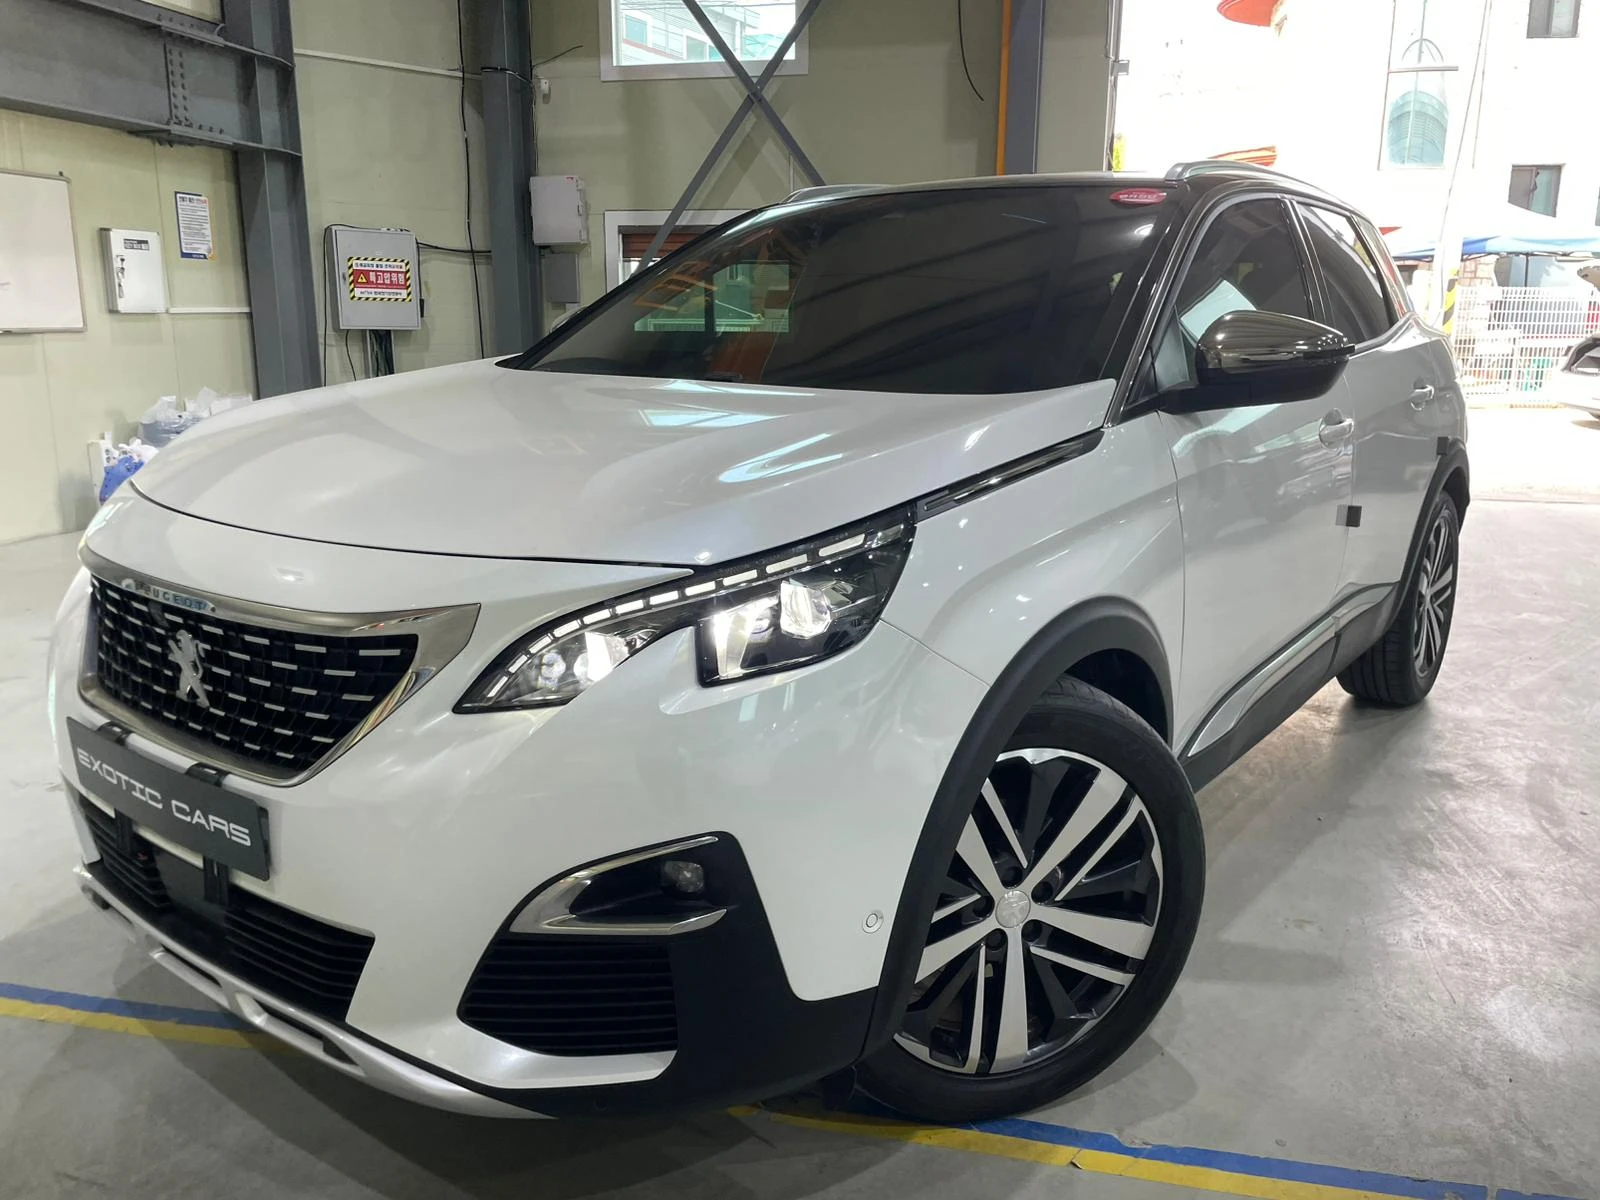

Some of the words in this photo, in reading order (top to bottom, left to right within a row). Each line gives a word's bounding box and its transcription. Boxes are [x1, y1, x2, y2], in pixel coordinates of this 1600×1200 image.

[139, 581, 208, 610] PEUGEOT
[76, 747, 163, 809] EXOTIC
[171, 799, 251, 846] CARS
